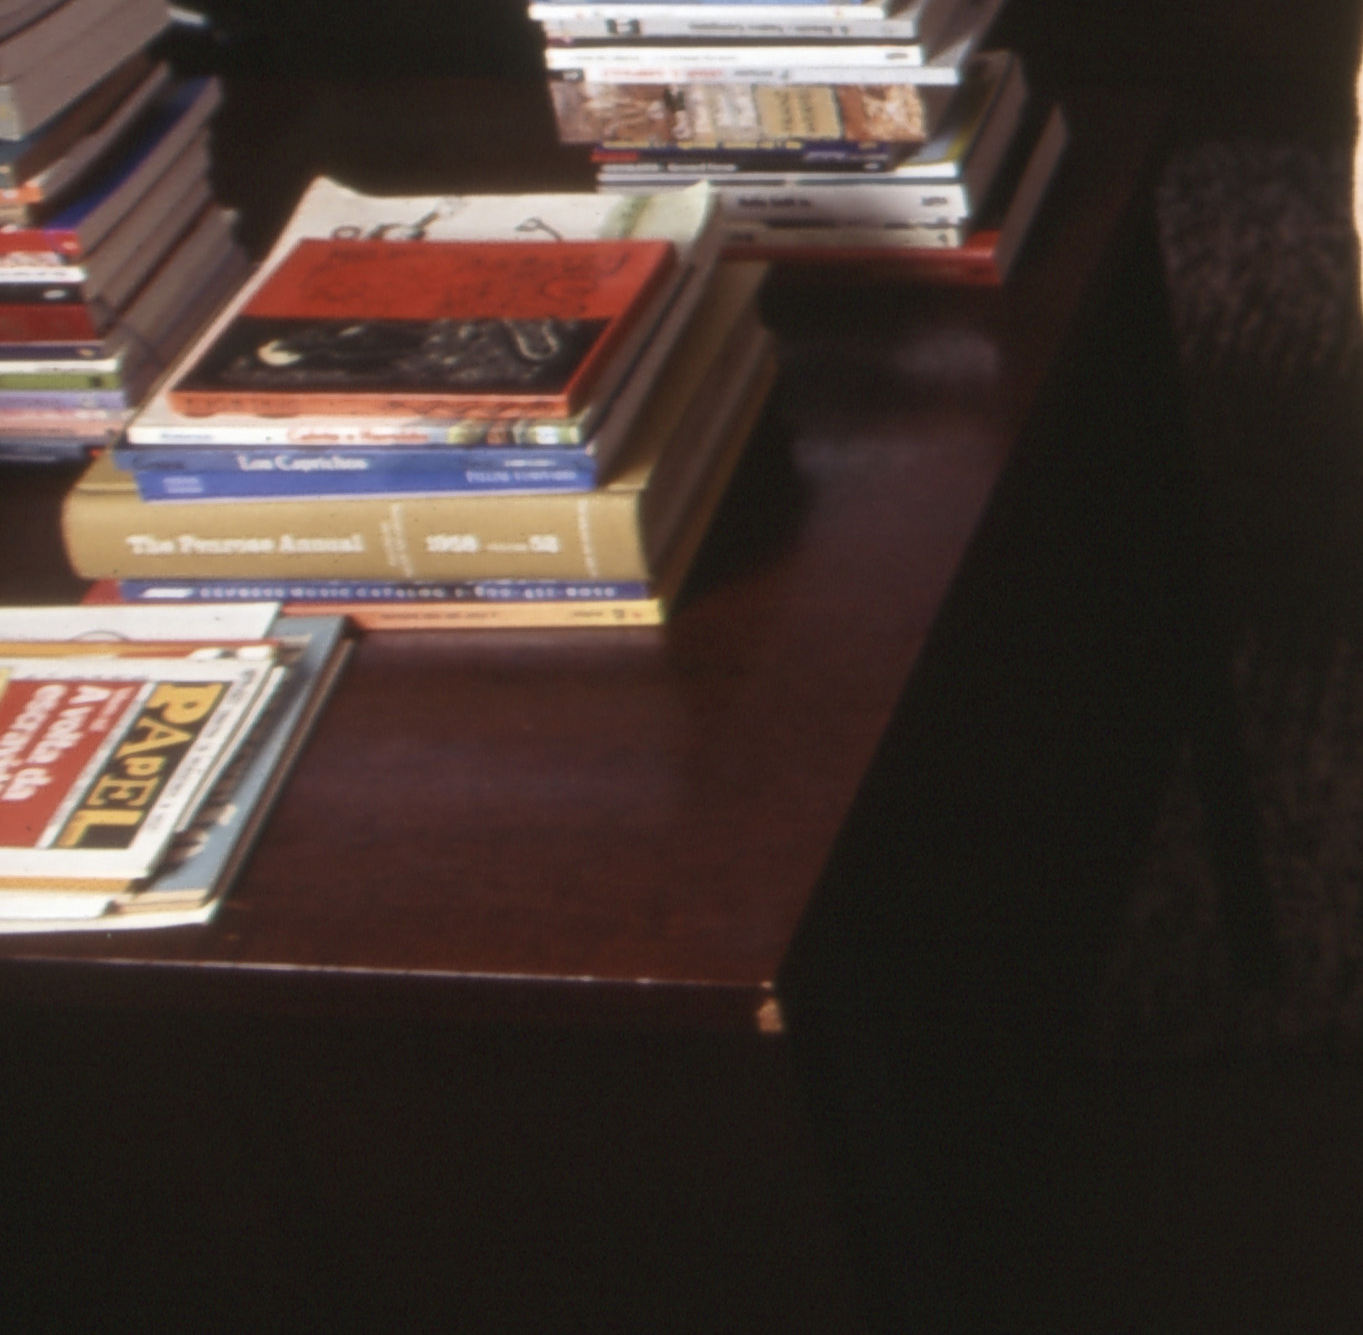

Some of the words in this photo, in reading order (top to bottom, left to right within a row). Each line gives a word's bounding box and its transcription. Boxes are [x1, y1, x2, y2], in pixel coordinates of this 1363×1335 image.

[236, 453, 273, 471] Los
[125, 535, 172, 555] The
[178, 534, 274, 554] Penrose
[278, 533, 364, 553] Annual
[69, 685, 111, 704] A
[27, 706, 93, 763] volta
[55, 683, 224, 847] PAPEL
[1, 768, 55, 801] da
